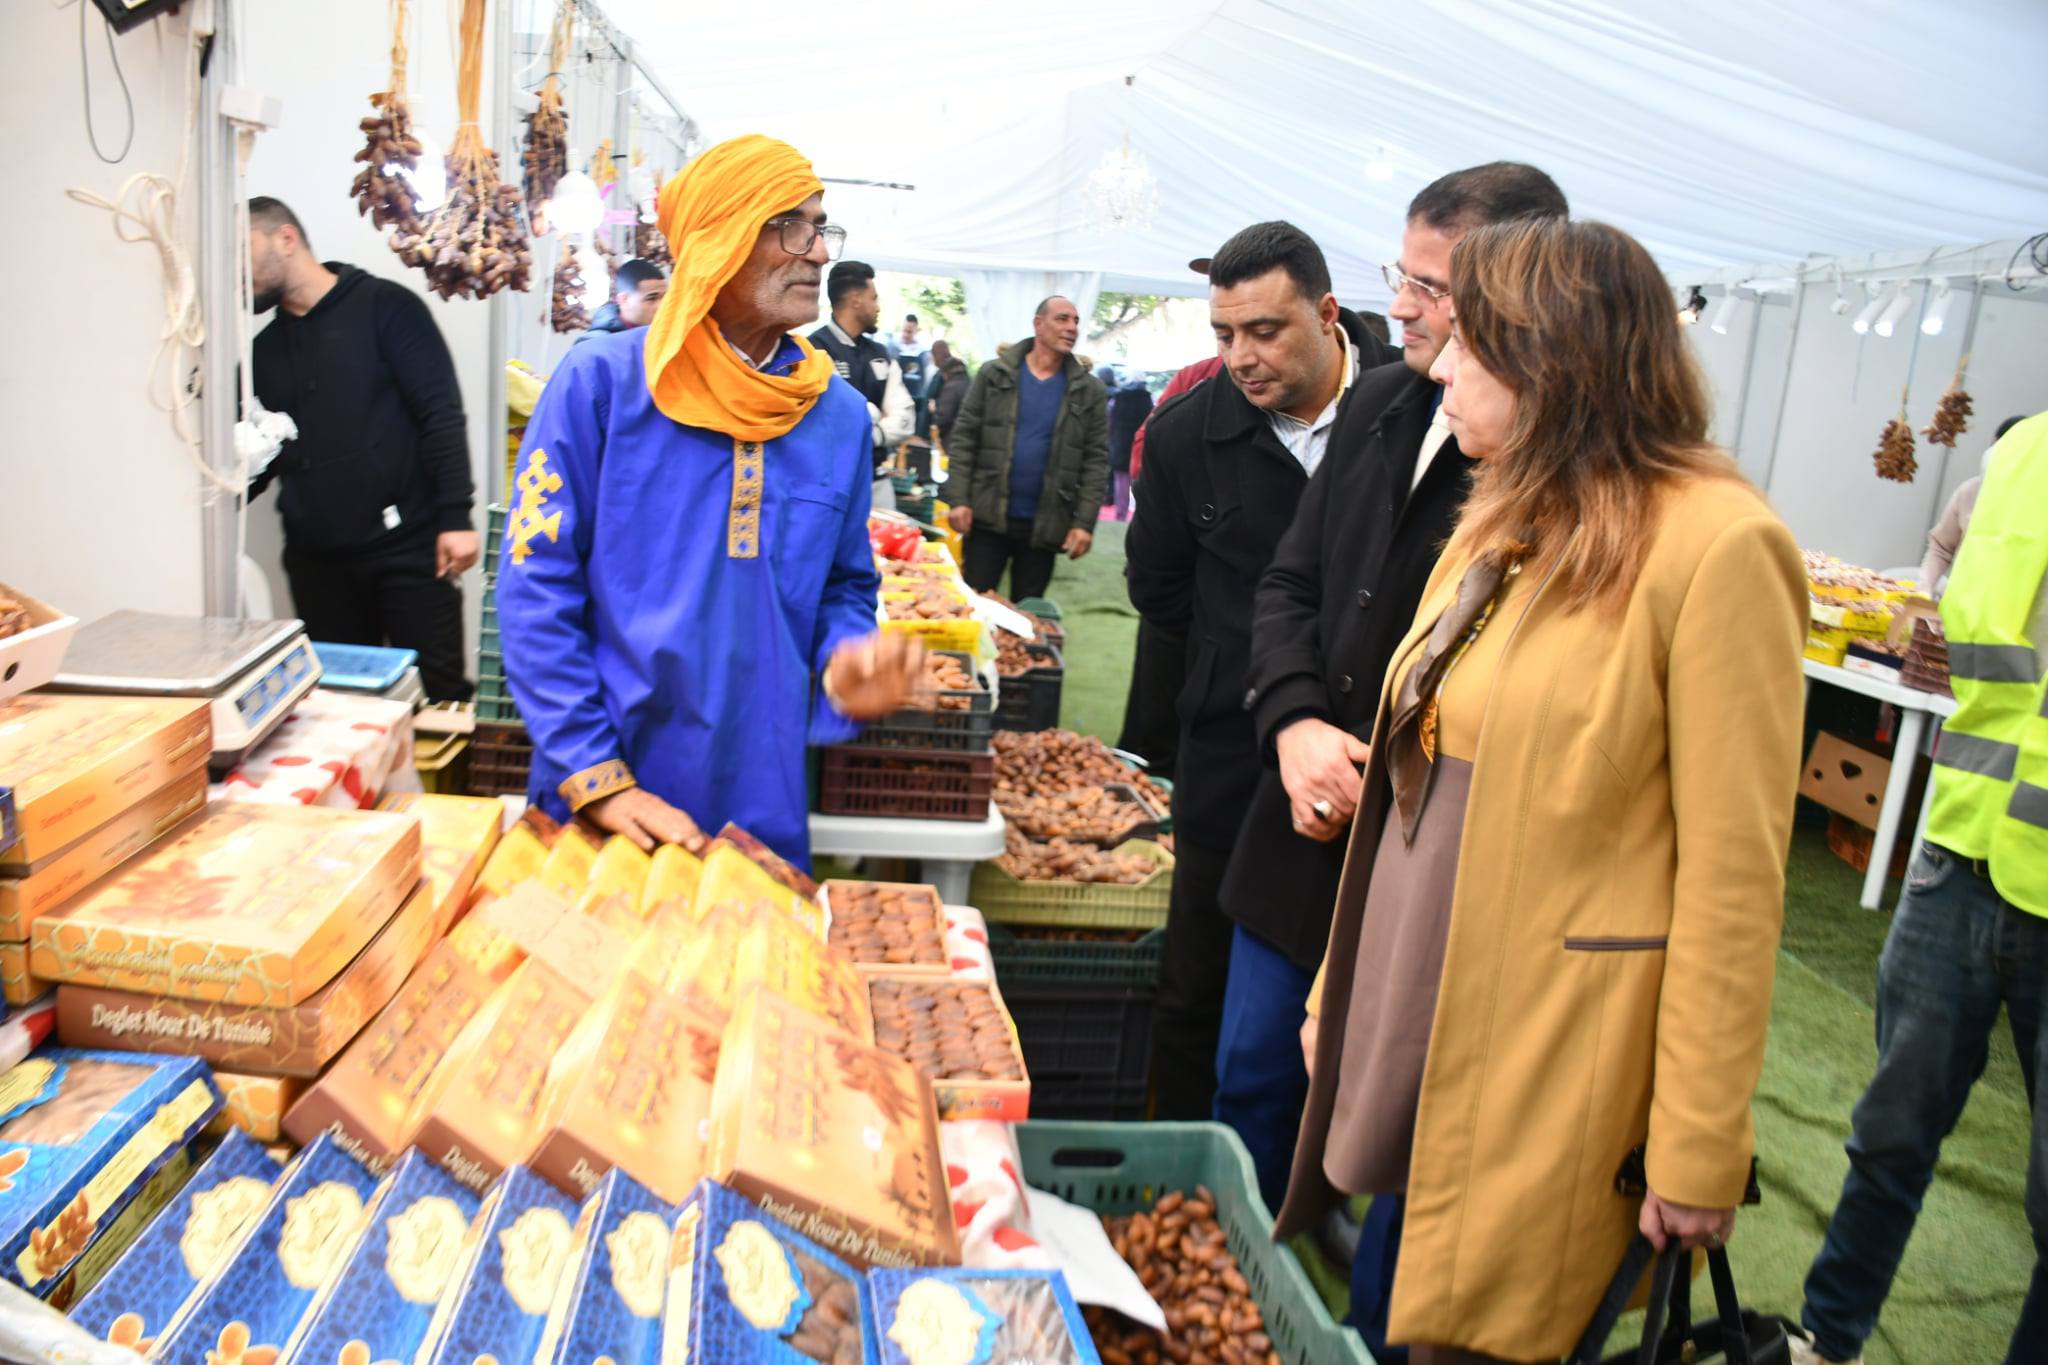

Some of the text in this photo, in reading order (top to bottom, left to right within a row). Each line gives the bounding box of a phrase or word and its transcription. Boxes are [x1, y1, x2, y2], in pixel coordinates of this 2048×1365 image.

[92, 1003, 272, 1045] Deglet Nour De Tunisie
[803, 1213, 843, 1247] Nour
[840, 1230, 863, 1254] De
